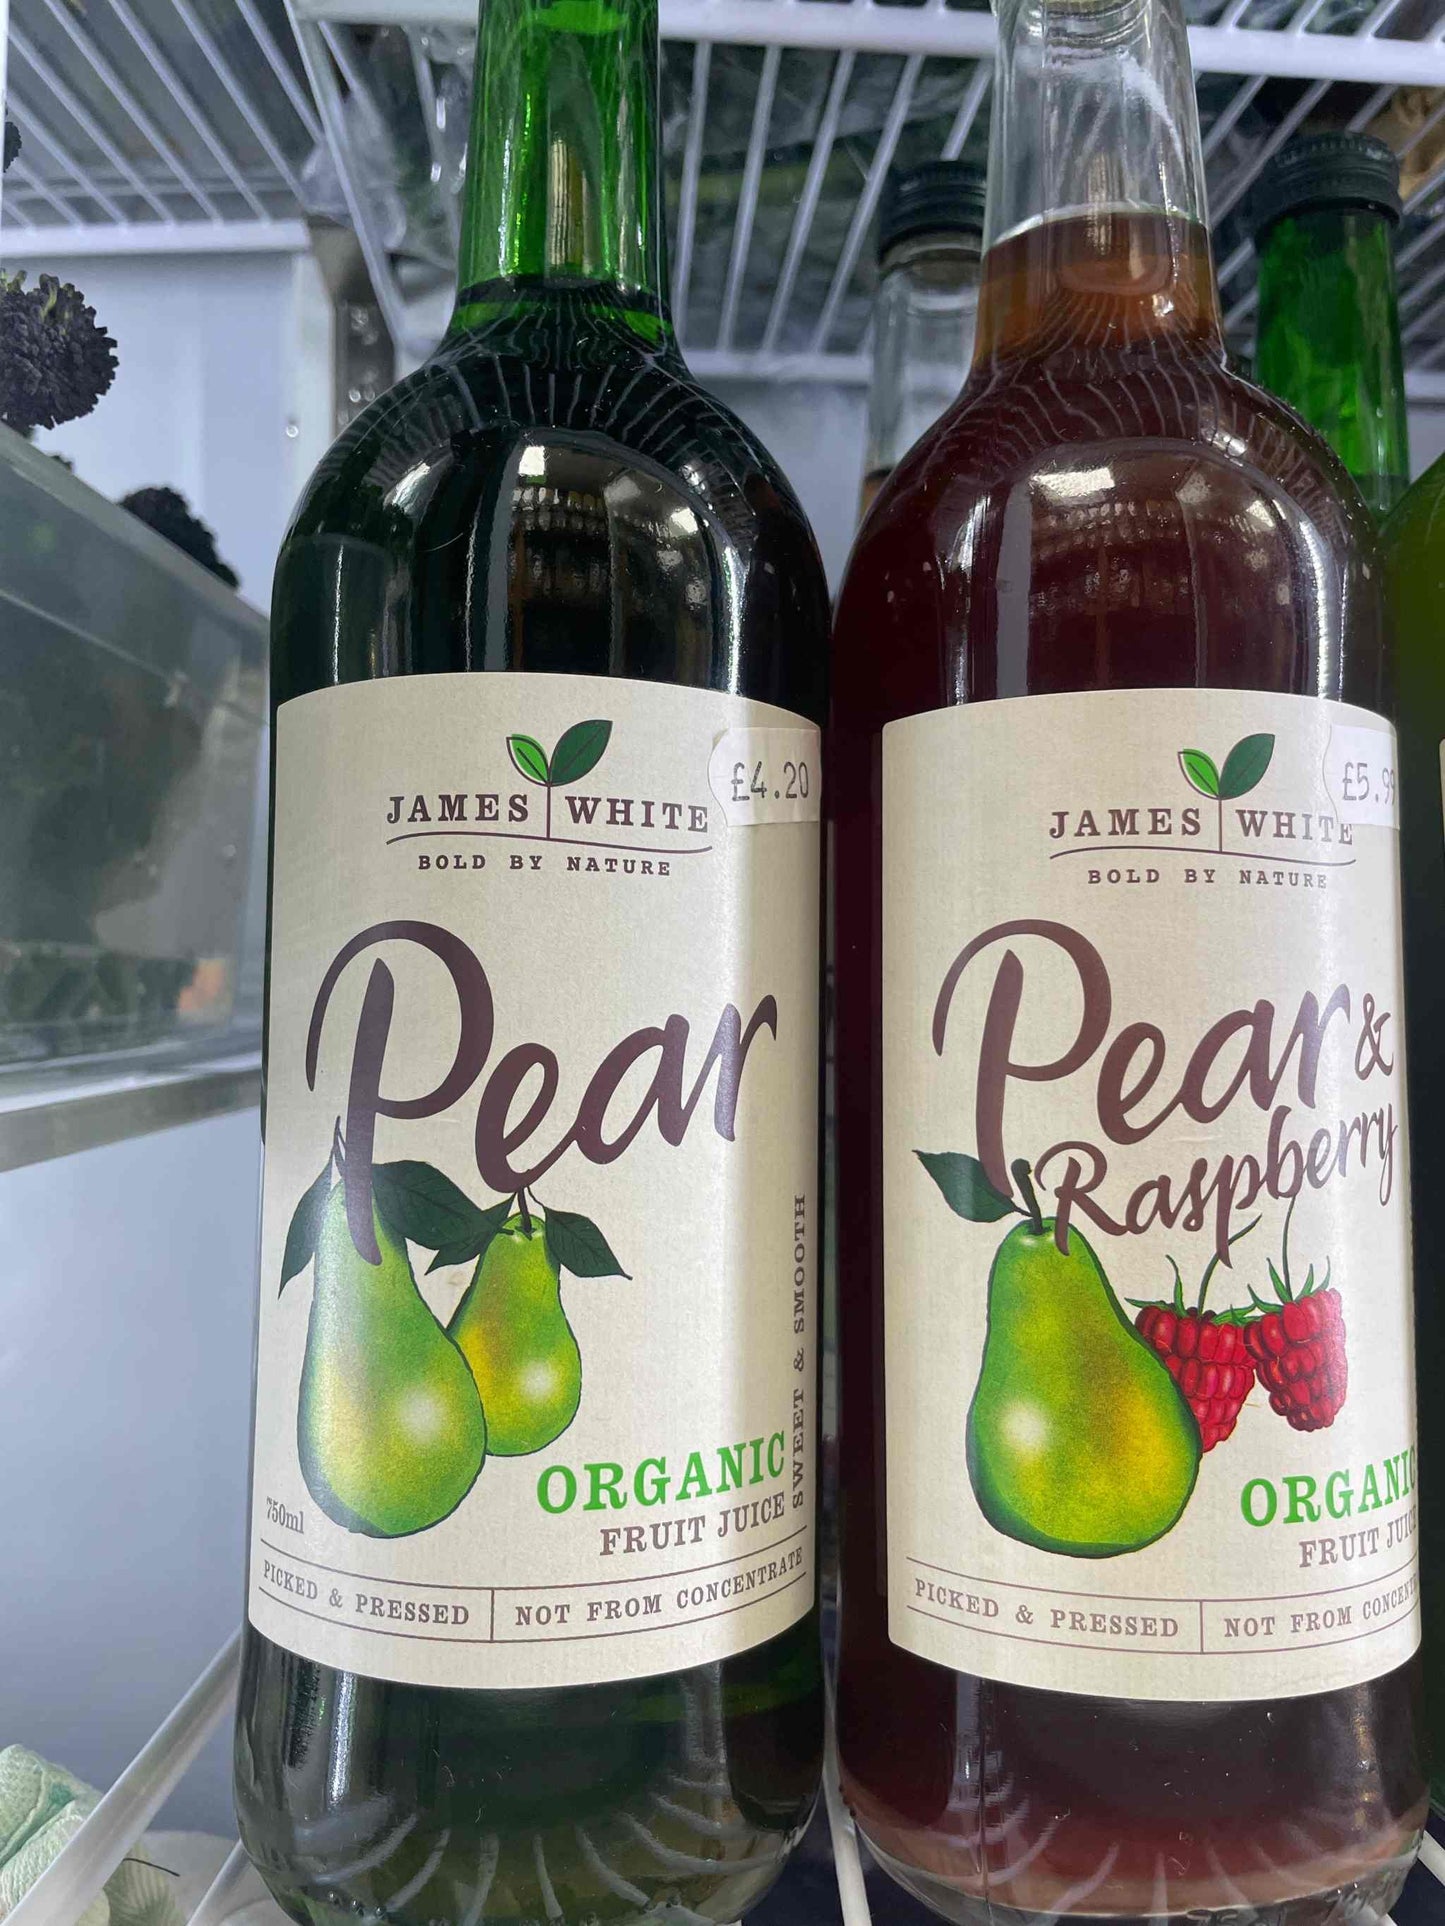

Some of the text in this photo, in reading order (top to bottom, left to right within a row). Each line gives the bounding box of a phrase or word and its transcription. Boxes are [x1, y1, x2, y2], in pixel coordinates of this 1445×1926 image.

[386, 794, 709, 833] JAMES WHITE
[731, 762, 811, 801] £4.20
[1049, 808, 1353, 846] JAMES WHITE
[418, 854, 671, 876] BOLD BY NATURE
[1088, 869, 1328, 889] BOLD BY NATURE
[932, 919, 1394, 1198] Pear &
[306, 920, 777, 1265] Pear
[1034, 1103, 1398, 1268] Raspberry
[792, 1194, 806, 1509] SWEET & SMOOTH
[537, 1431, 785, 1514] ORGANIC
[1241, 1445, 1416, 1527] ORGANIC
[266, 1496, 304, 1534] 750ml
[599, 1491, 785, 1556] FRUIT JUICE
[1299, 1527, 1380, 1568] FRUIT
[263, 1559, 469, 1625] PICKED & PRESSED
[515, 1546, 804, 1627] NOT FROM CONCENTRATE
[914, 1578, 1179, 1637] PICKED & PRESSED
[1224, 1572, 1417, 1638] NOT FROM CONCENT
